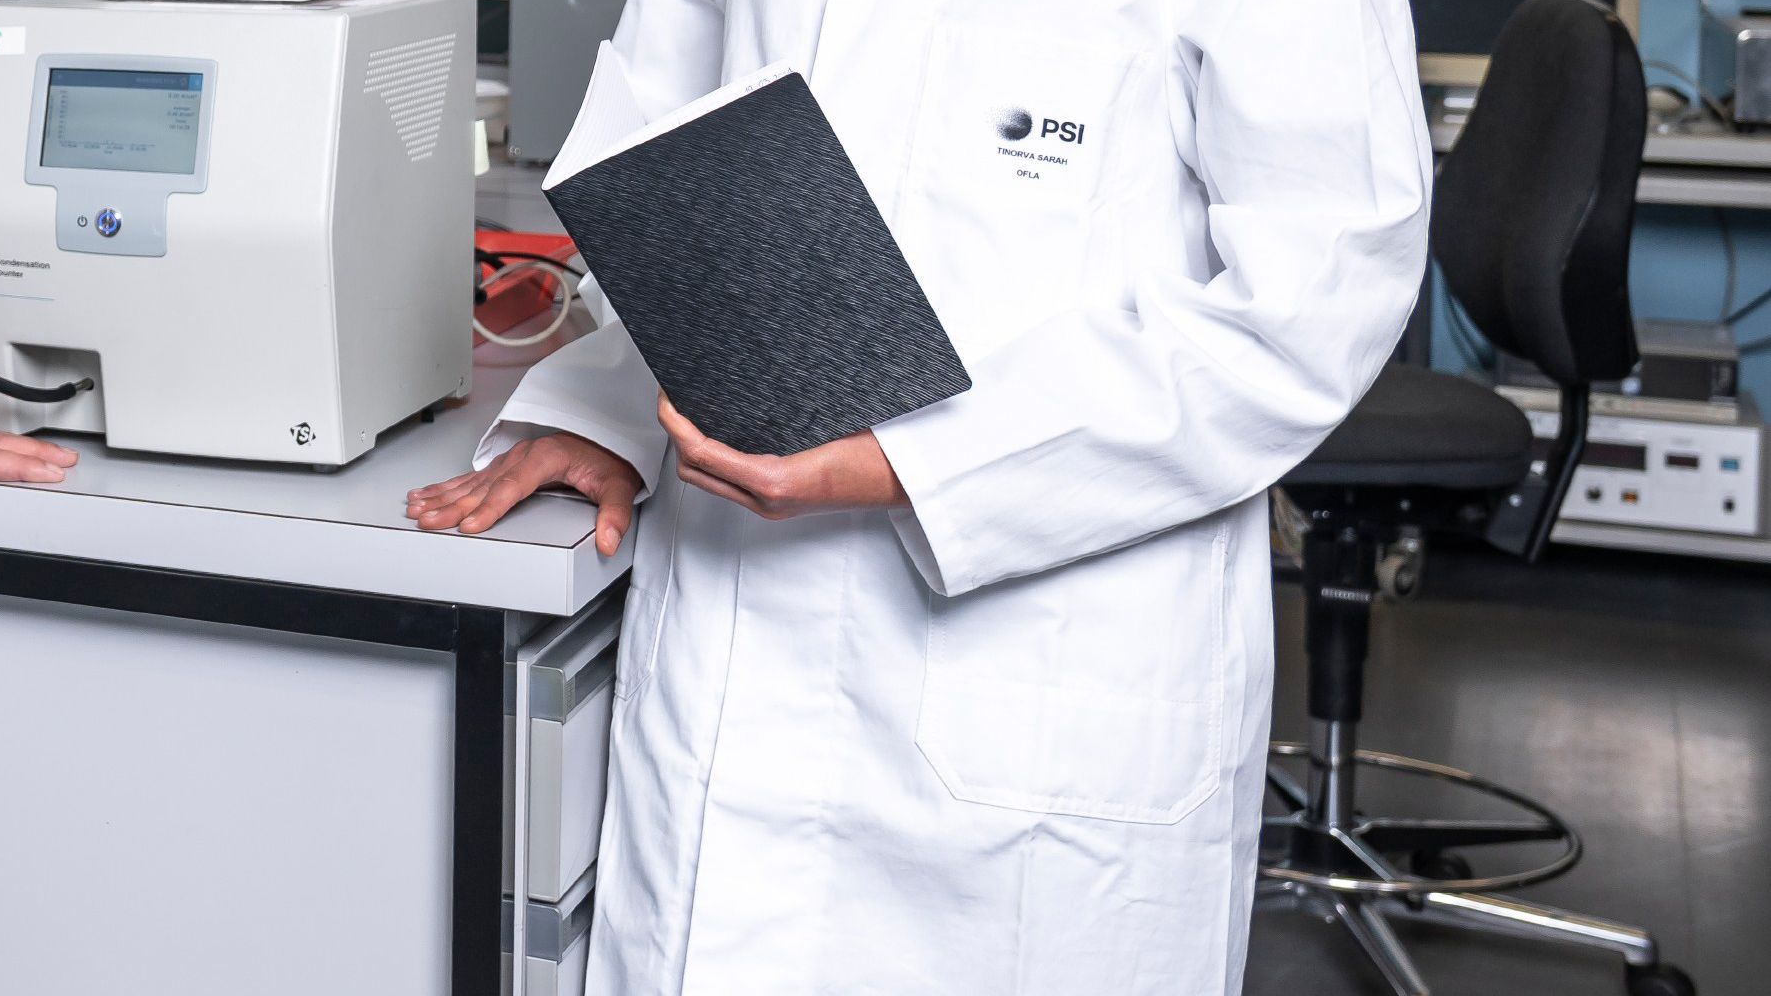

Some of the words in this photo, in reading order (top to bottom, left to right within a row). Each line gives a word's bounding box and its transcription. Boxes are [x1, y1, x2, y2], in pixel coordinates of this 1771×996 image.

[1040, 118, 1085, 145] PSI
[997, 147, 1035, 160] TINORVA
[1037, 154, 1068, 166] SARAH
[1016, 169, 1040, 180] OFLA
[289, 421, 317, 446] TSI
